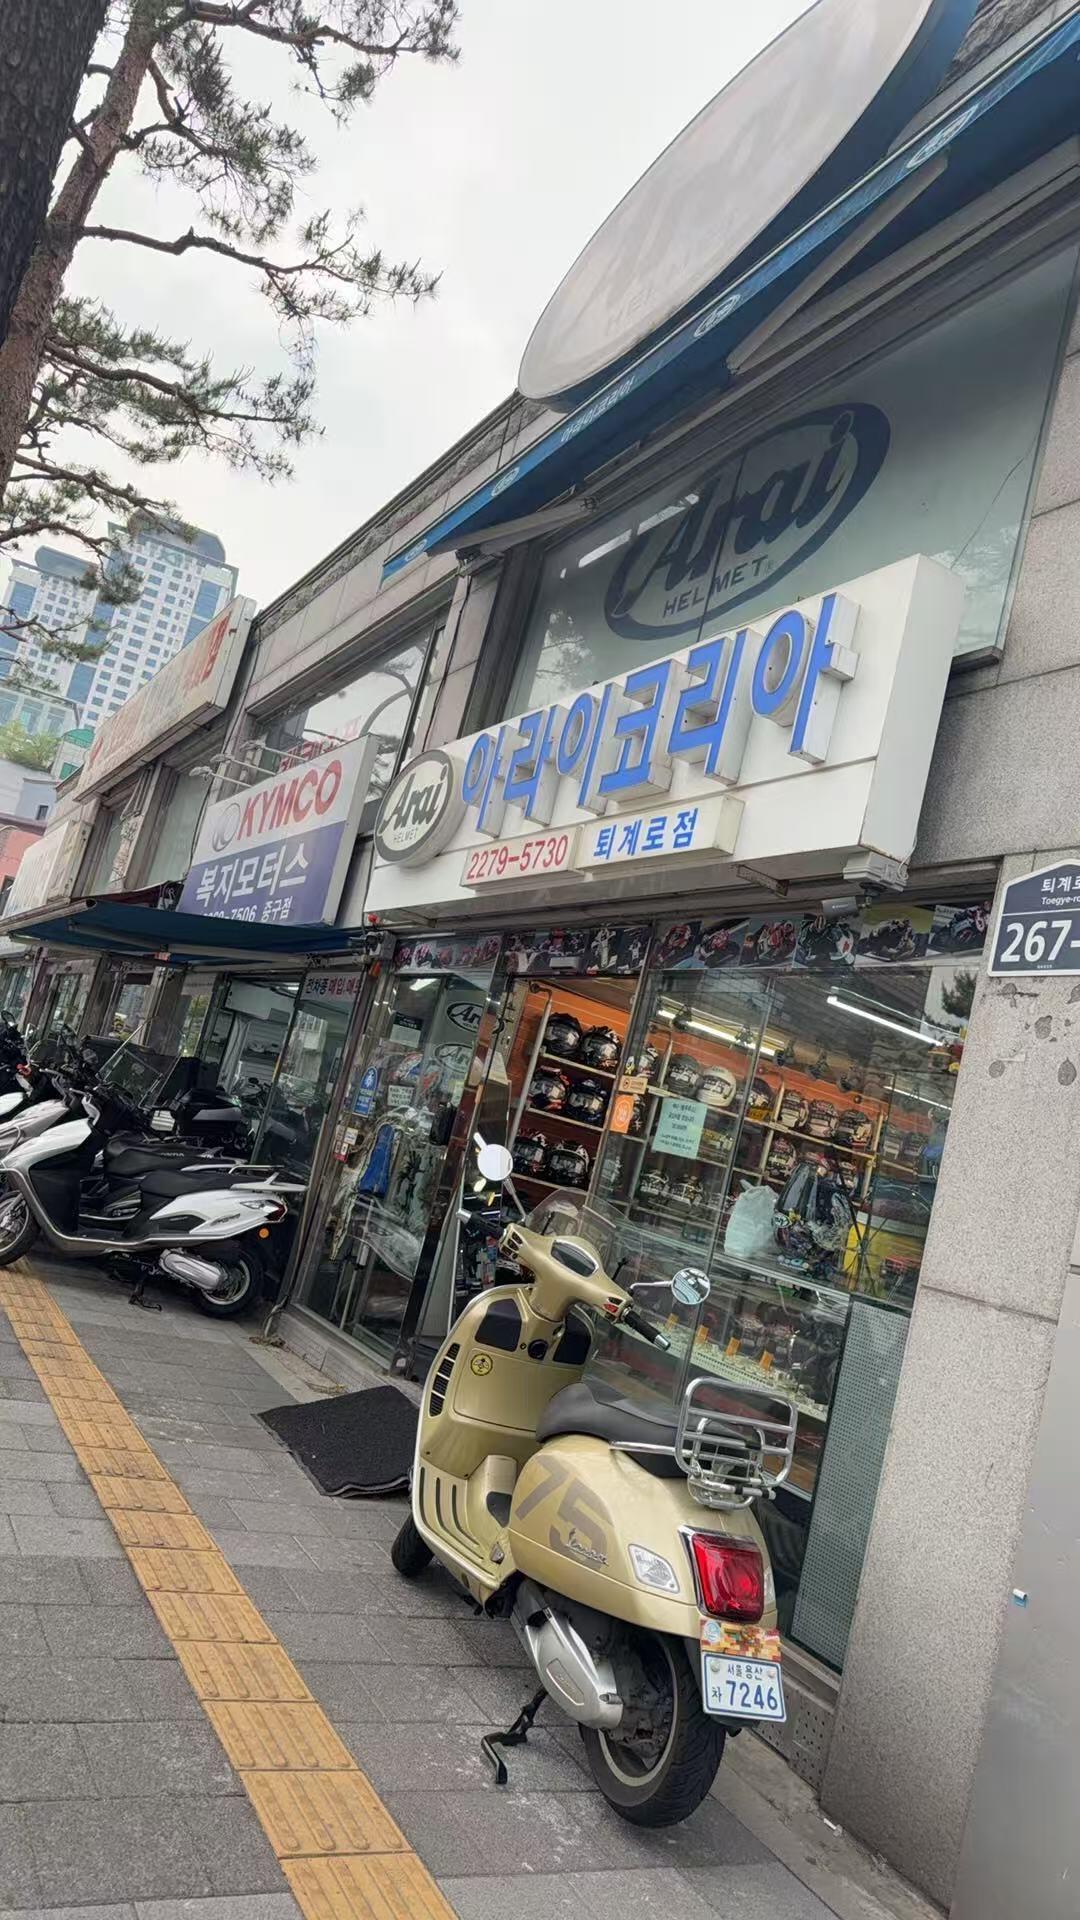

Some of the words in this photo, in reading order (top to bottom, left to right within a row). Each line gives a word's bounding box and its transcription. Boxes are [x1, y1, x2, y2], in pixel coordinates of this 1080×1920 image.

[613, 410, 854, 618] Arai
[663, 555, 769, 618] HELMET
[461, 592, 842, 832] 아라이코리아
[237, 760, 342, 840] KYMCO
[378, 765, 448, 831] Arai
[466, 834, 569, 880] 2279-5730
[593, 808, 699, 860] 퇴계로점
[196, 843, 309, 908] 복지모터스
[202, 905, 258, 922] -7506
[261, 896, 294, 922] 중구점
[1000, 919, 1080, 962] 267-
[515, 1455, 615, 1568] 75
[725, 1680, 778, 1711] 7246
